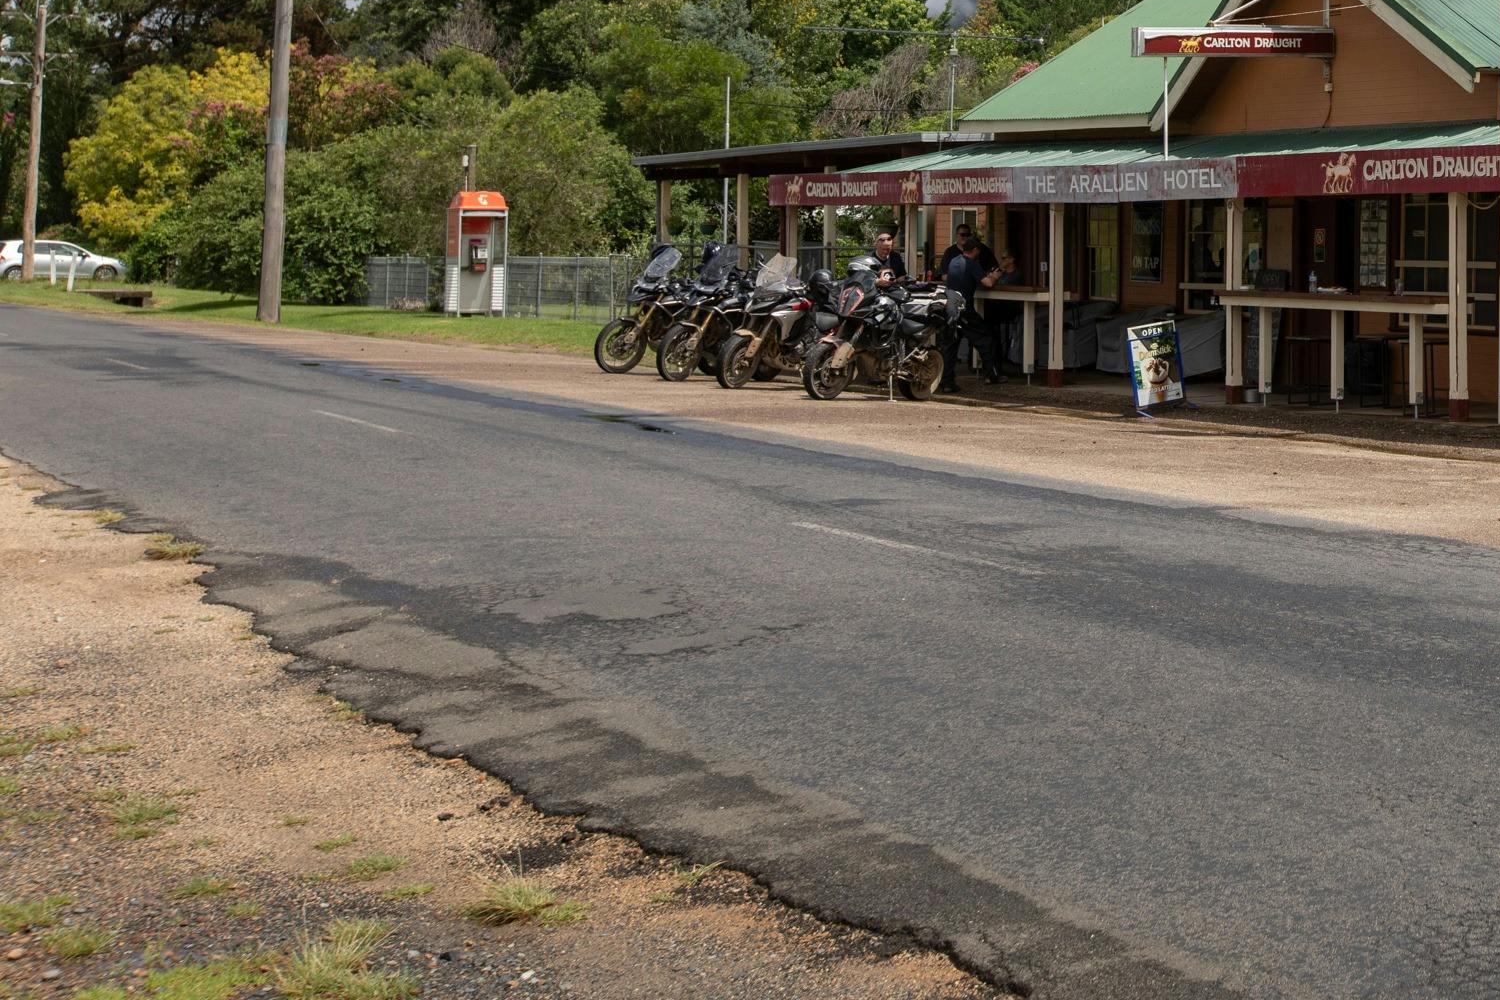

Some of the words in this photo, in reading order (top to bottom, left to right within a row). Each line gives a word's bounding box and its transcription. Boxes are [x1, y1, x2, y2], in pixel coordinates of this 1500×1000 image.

[1203, 36, 1250, 48] CARLTON
[1254, 36, 1302, 48] DRAUGHT
[1362, 157, 1429, 181] CARLTON
[806, 181, 839, 197] CARLTON
[841, 180, 878, 197] DRAUGHT
[924, 178, 962, 195] CARLTON
[964, 176, 1008, 194] DRAUGHT
[1025, 175, 1056, 194] THE
[1069, 171, 1148, 193] ARALUEN
[1163, 168, 1222, 190] HOTEL
[1144, 256, 1159, 269] TAP
[1141, 327, 1163, 337] OPEN
